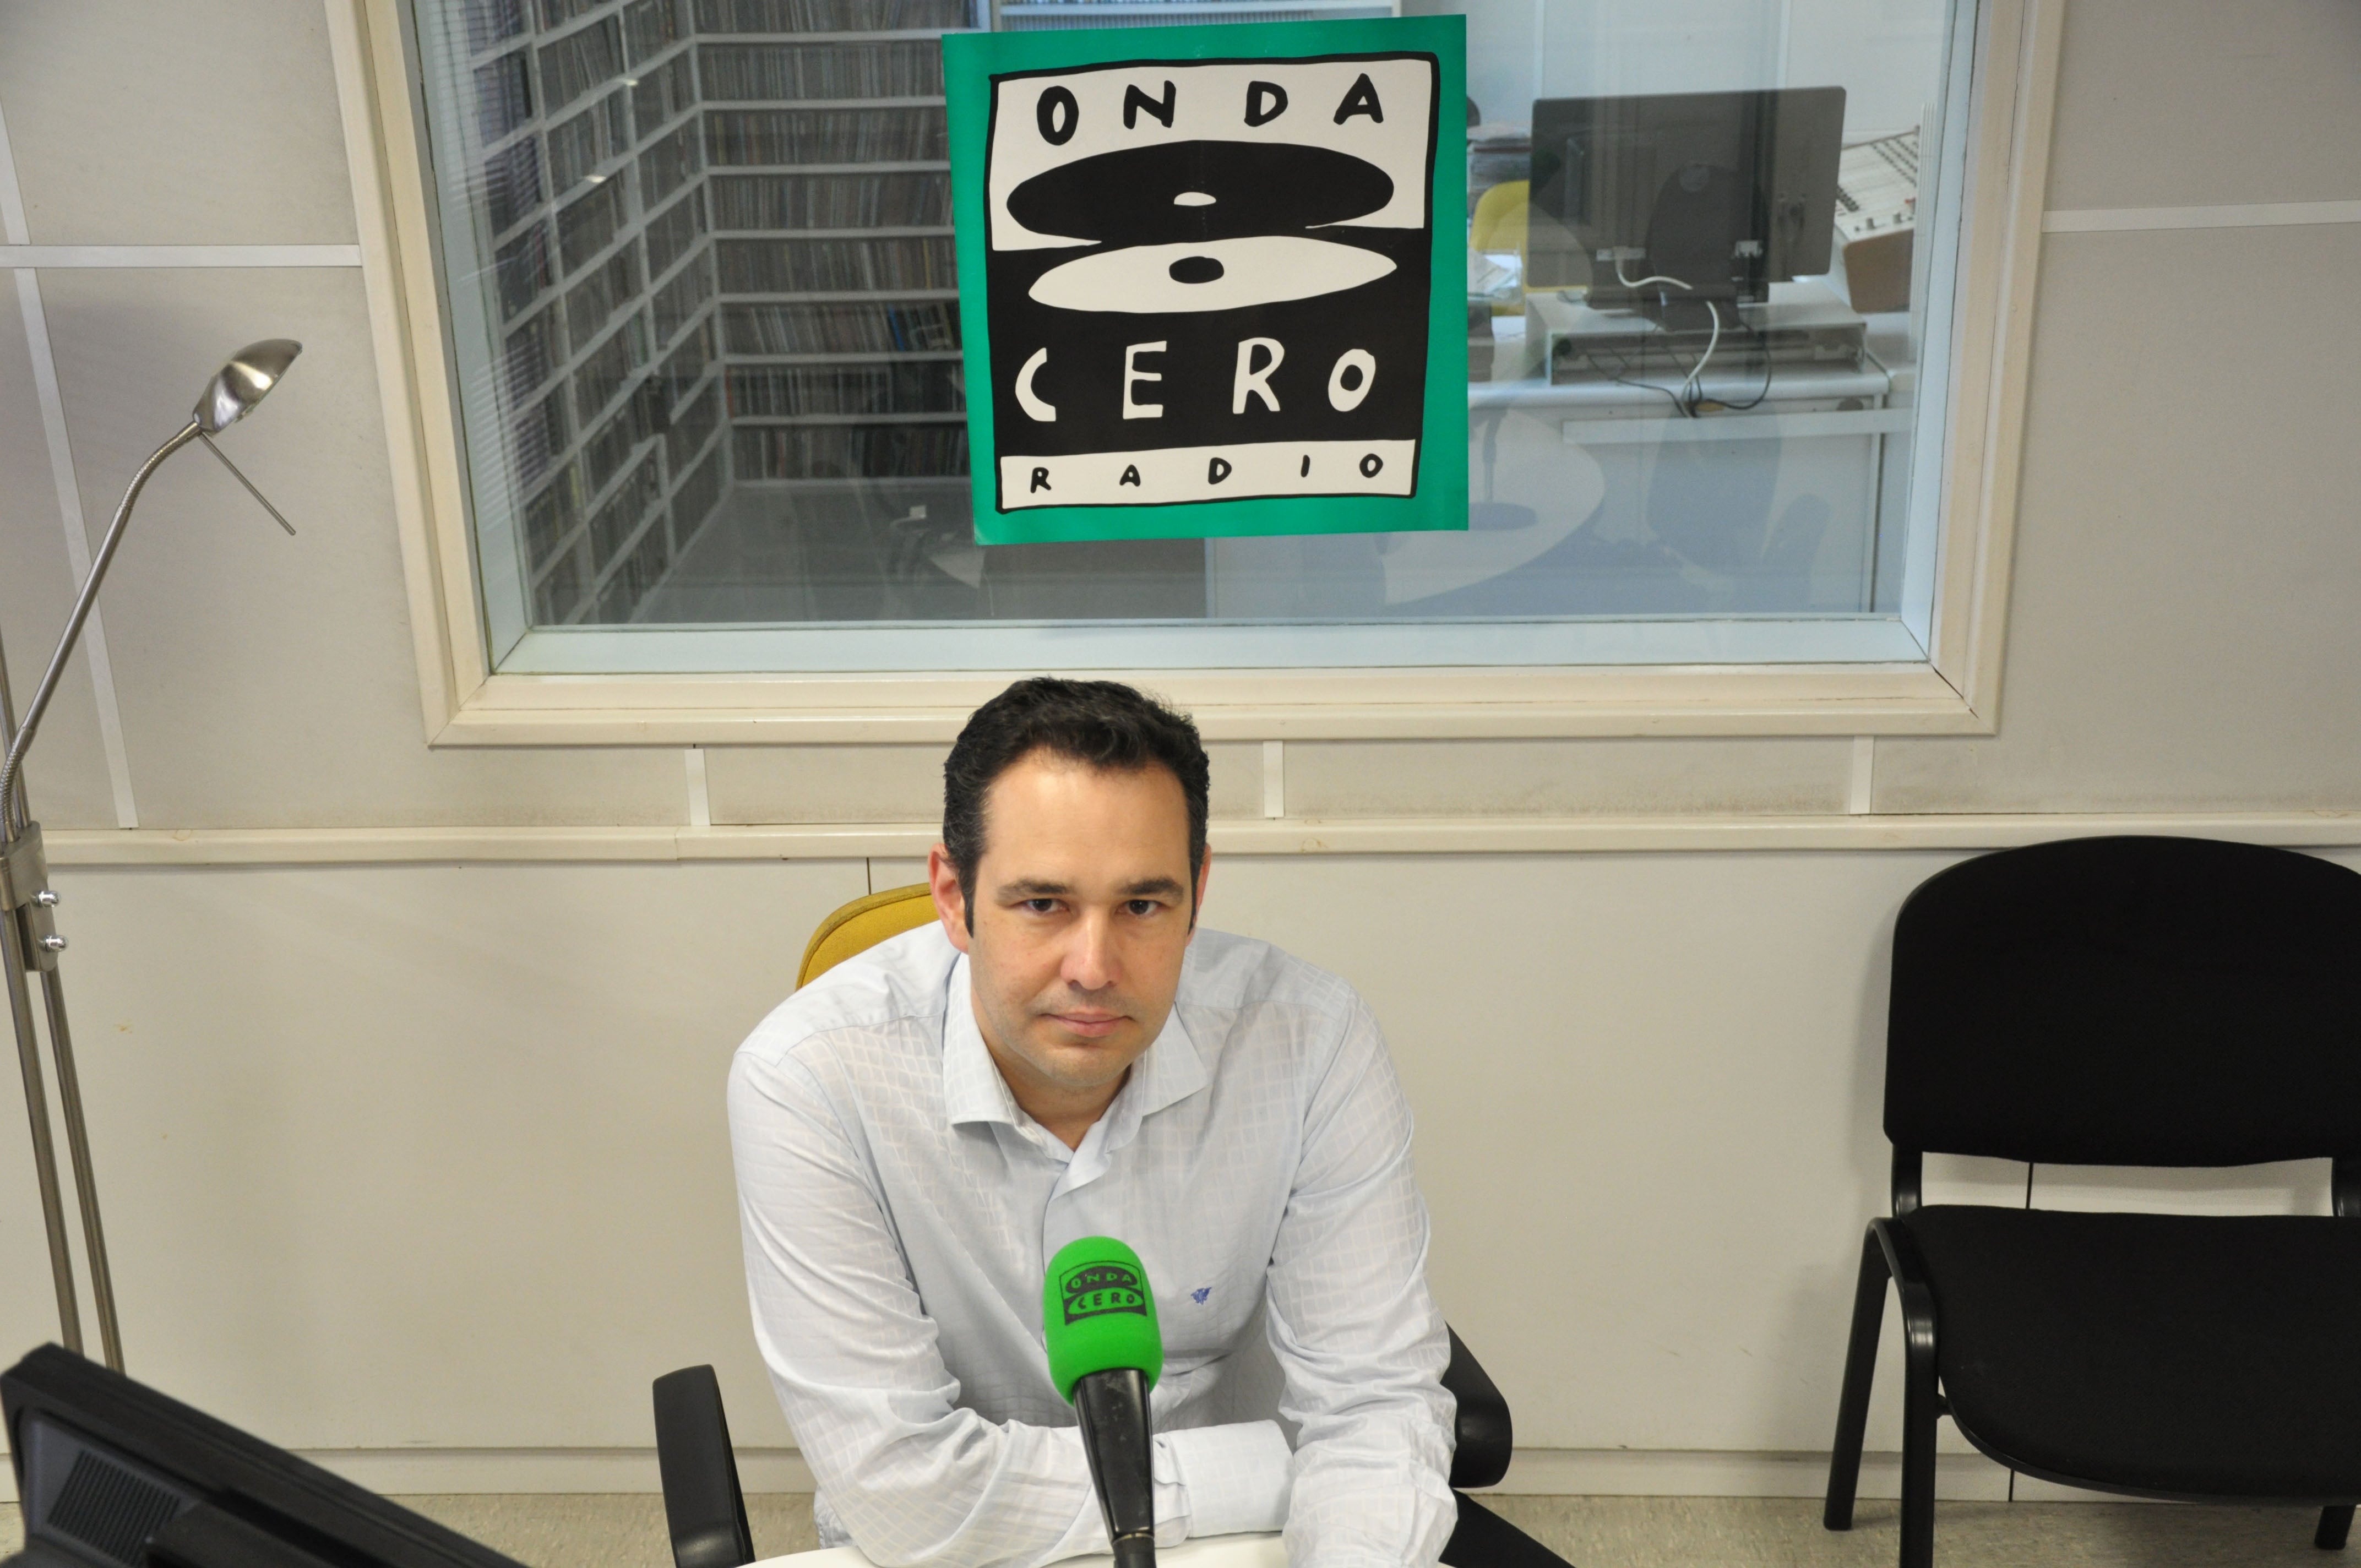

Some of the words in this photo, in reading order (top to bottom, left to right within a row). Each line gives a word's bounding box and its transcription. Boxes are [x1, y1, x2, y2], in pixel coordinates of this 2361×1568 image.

[1037, 73, 1384, 146] ONDA
[1015, 337, 1376, 422] CERO
[1030, 454, 1383, 493] RADIO
[1070, 1272, 1133, 1289] ONDA
[1077, 1292, 1135, 1309] CERO
